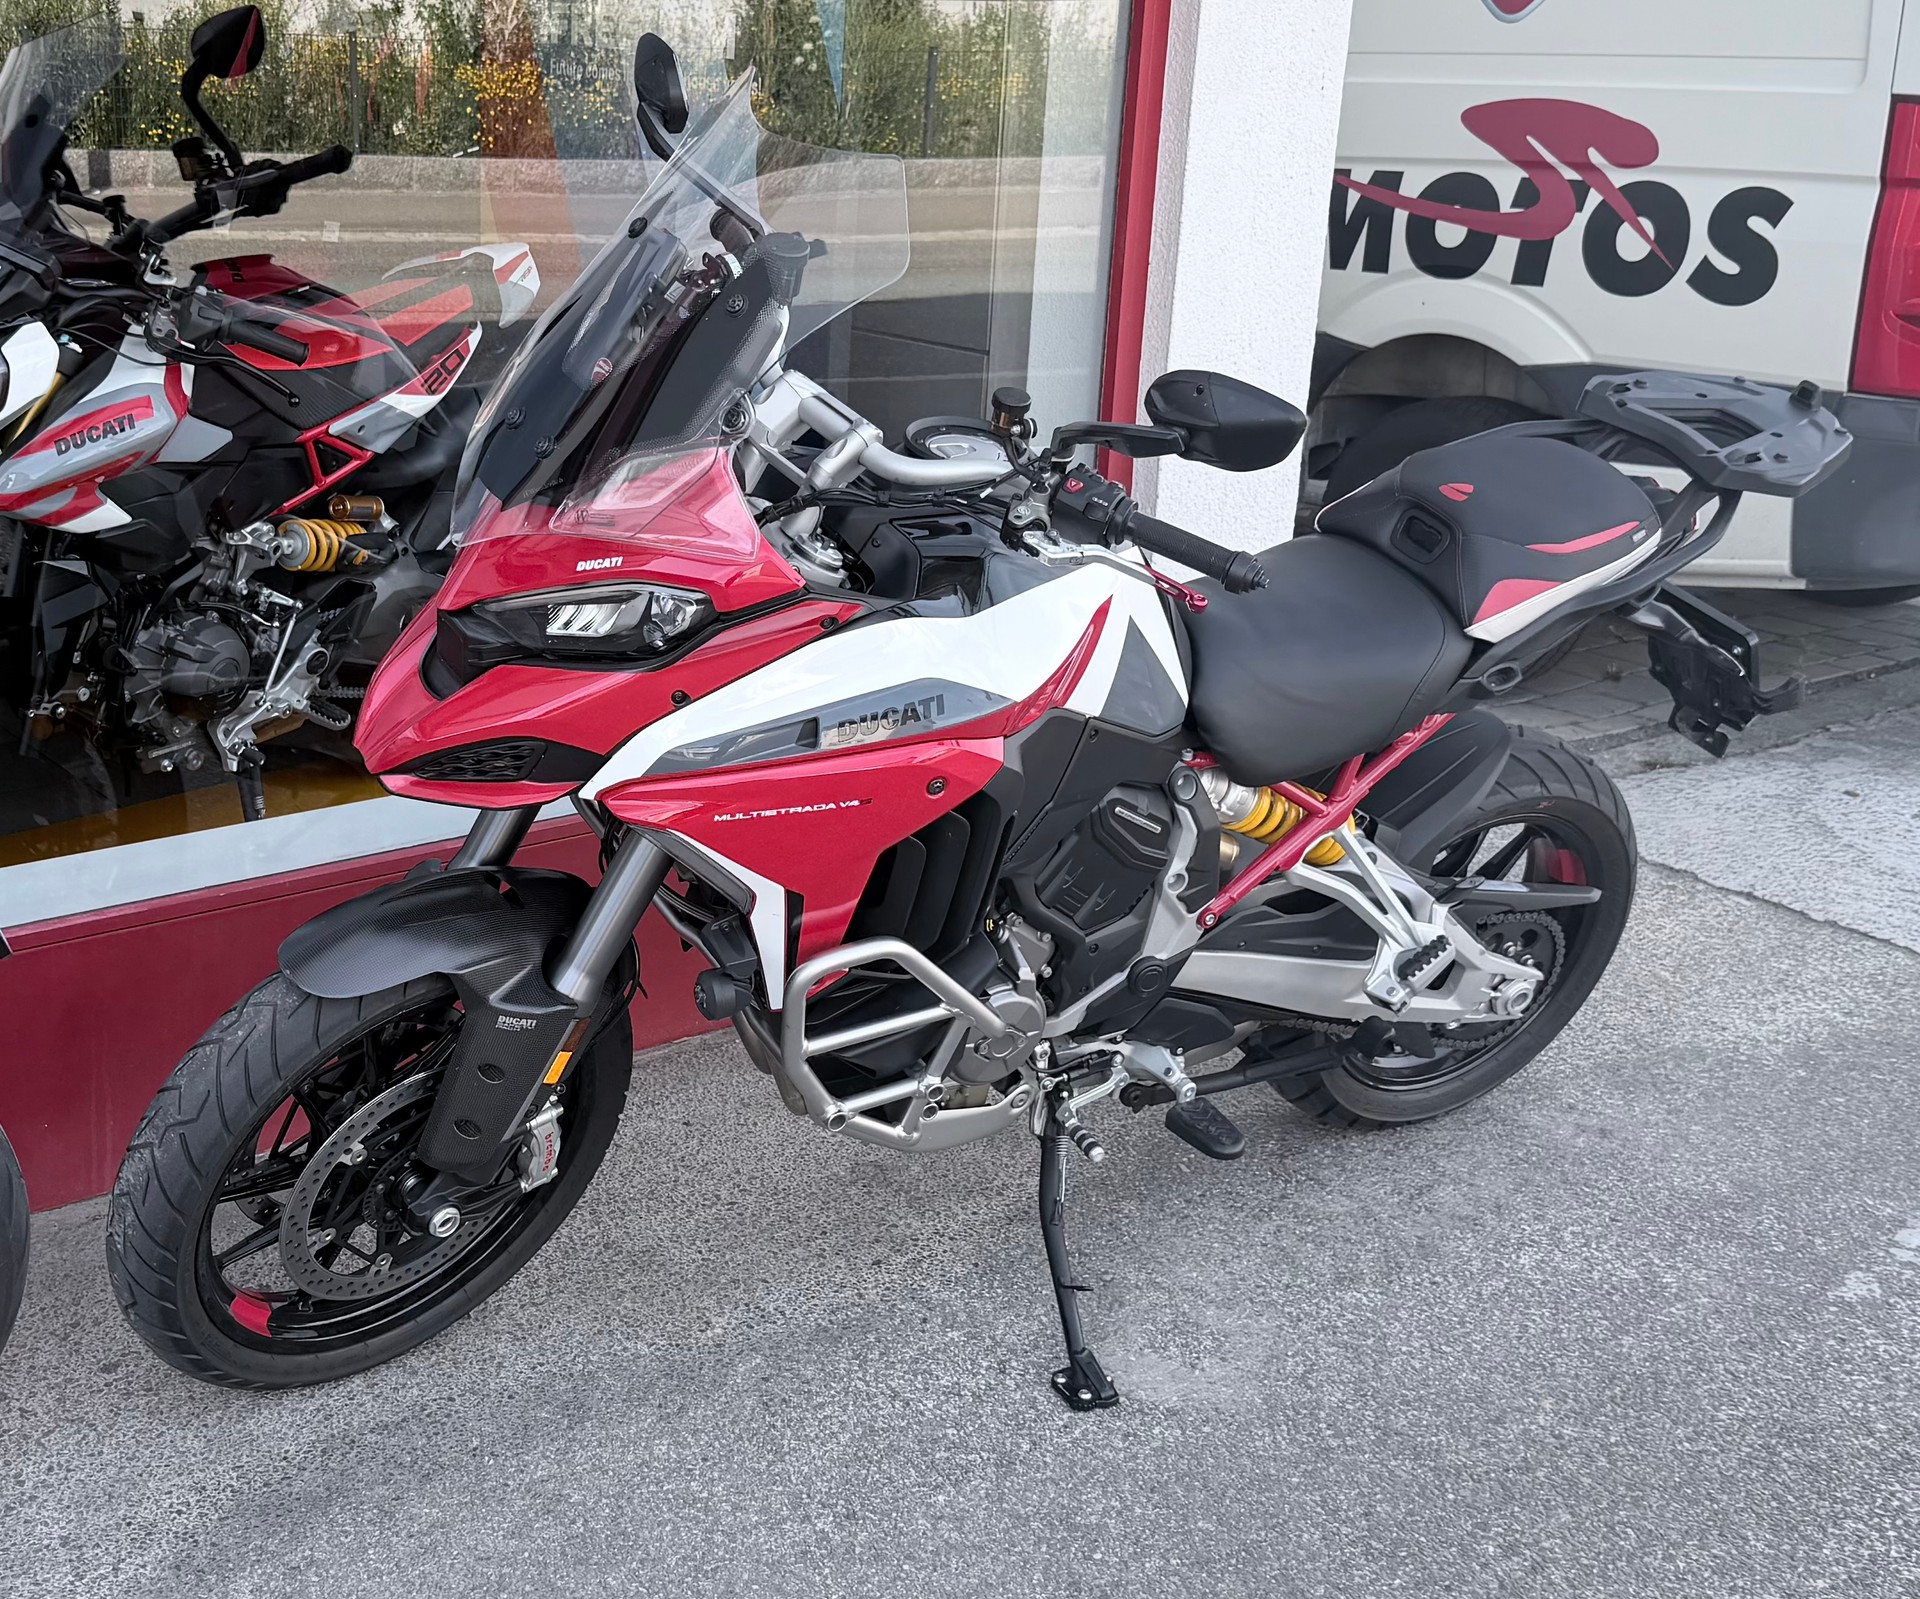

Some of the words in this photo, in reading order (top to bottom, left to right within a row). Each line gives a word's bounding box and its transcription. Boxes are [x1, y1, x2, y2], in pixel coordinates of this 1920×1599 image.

[550, 58, 583, 79] Future
[586, 65, 622, 82] comes
[1328, 168, 1794, 307] MOTOS
[54, 413, 136, 456] DUCATI
[576, 557, 623, 571] DUCATI
[838, 694, 945, 742] DUCATI
[714, 803, 837, 822] MULTISTRADA
[497, 1015, 537, 1028] DUCATI
[542, 1131, 554, 1172] brembo
